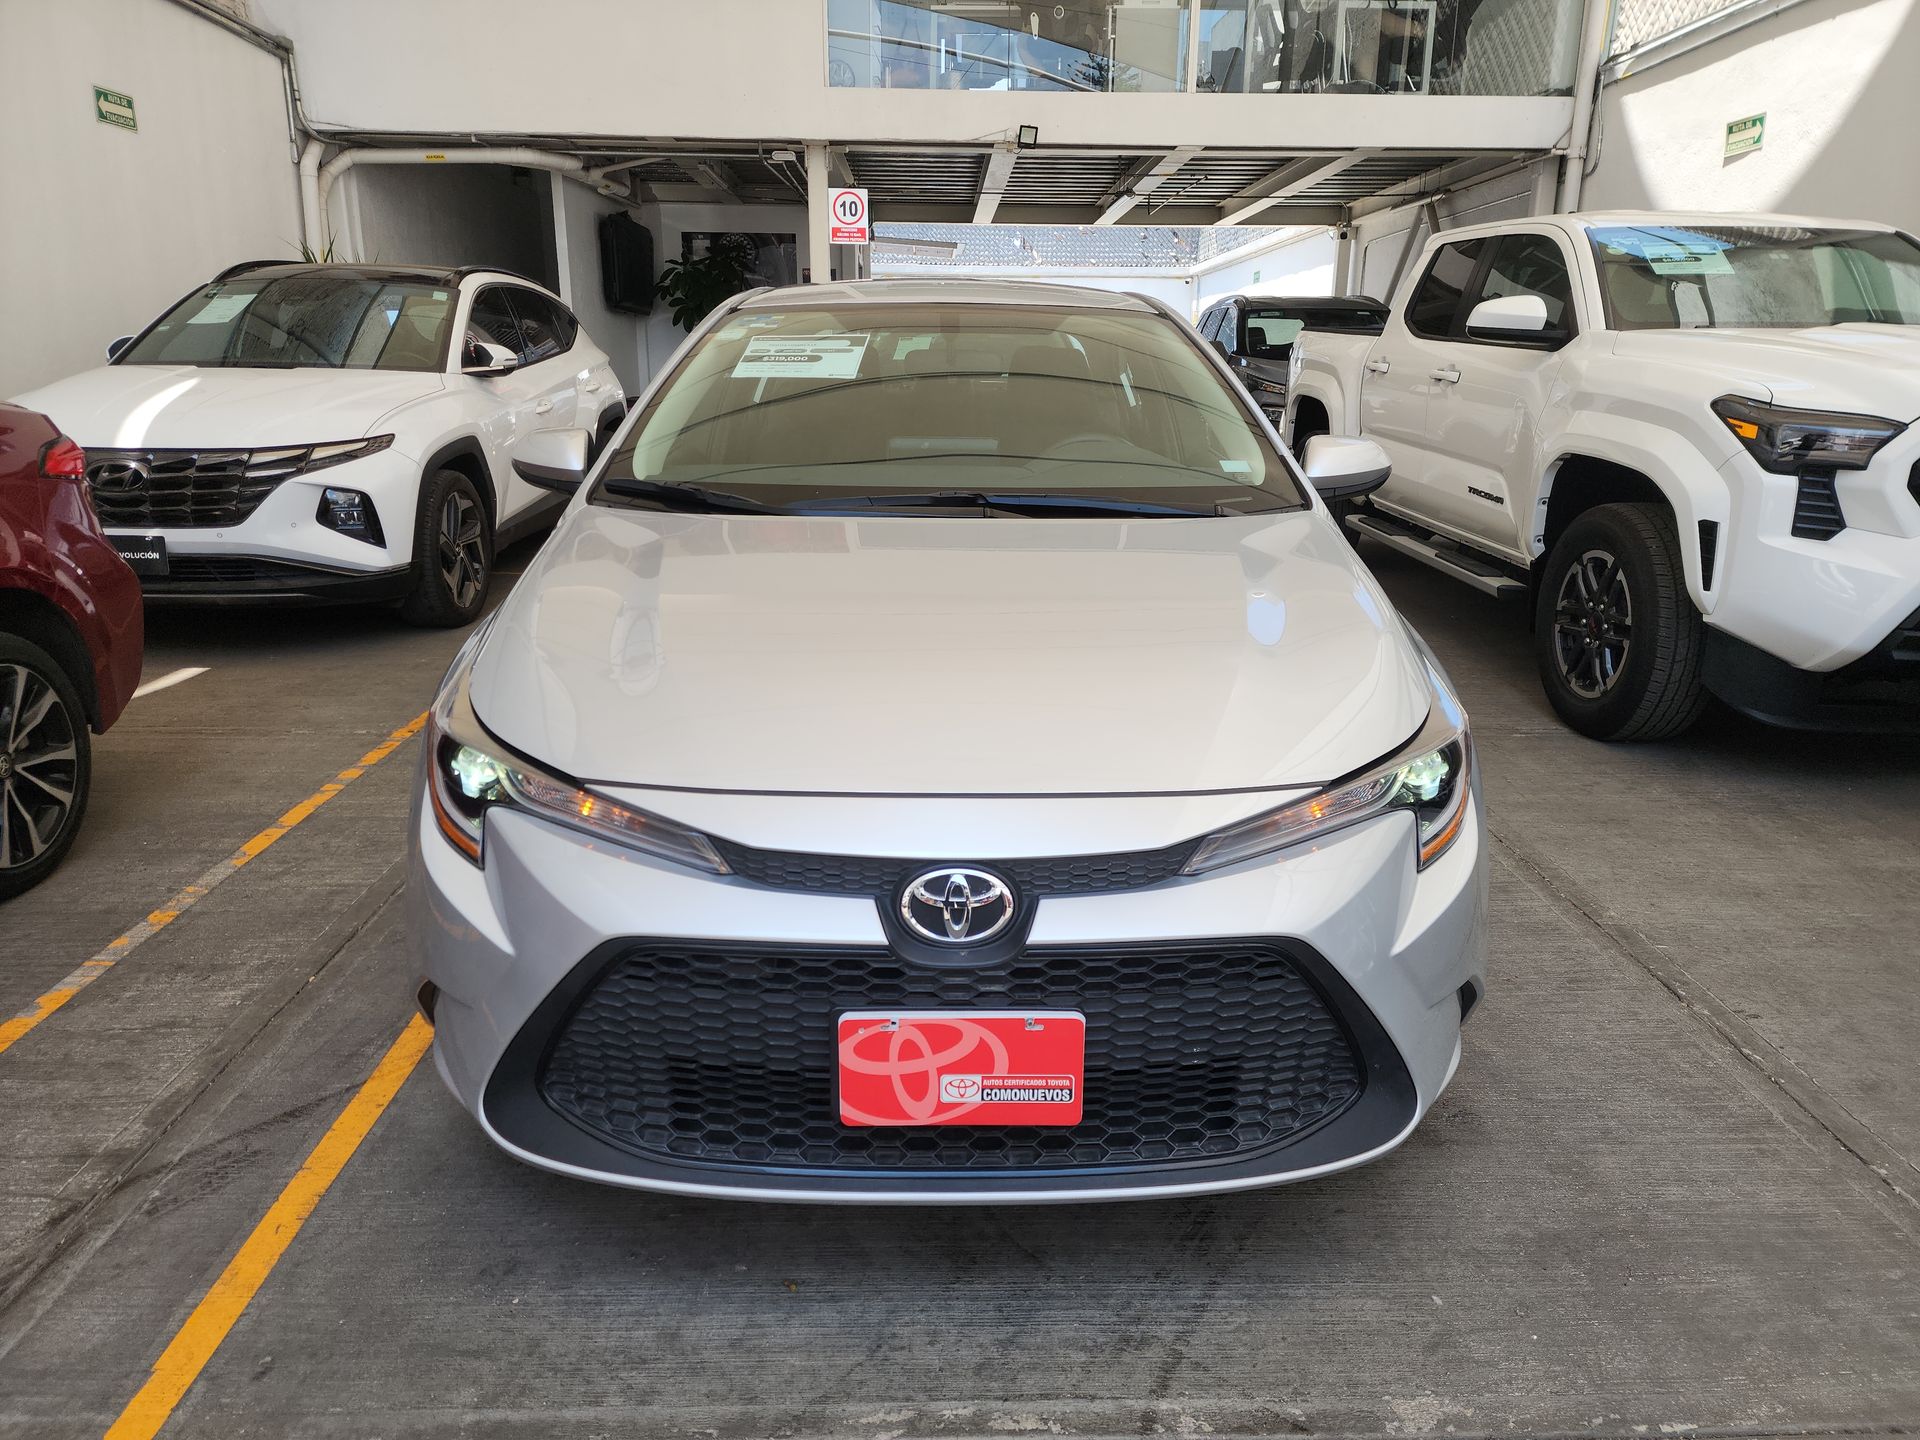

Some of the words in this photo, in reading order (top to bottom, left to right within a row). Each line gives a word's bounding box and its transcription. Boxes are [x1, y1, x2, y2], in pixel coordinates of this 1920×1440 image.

[107, 93, 121, 105] RUTA
[120, 98, 129, 107] DE
[840, 200, 858, 217] 10
[1467, 485, 1504, 505] TACOMA
[119, 550, 160, 559] VOLUCIÓN
[982, 1079, 1003, 1087] AUTOS
[1003, 1079, 1047, 1087] CERTIFICADOS
[1047, 1079, 1071, 1087] TOYOTA
[982, 1088, 1071, 1102] COMONUEVOS
